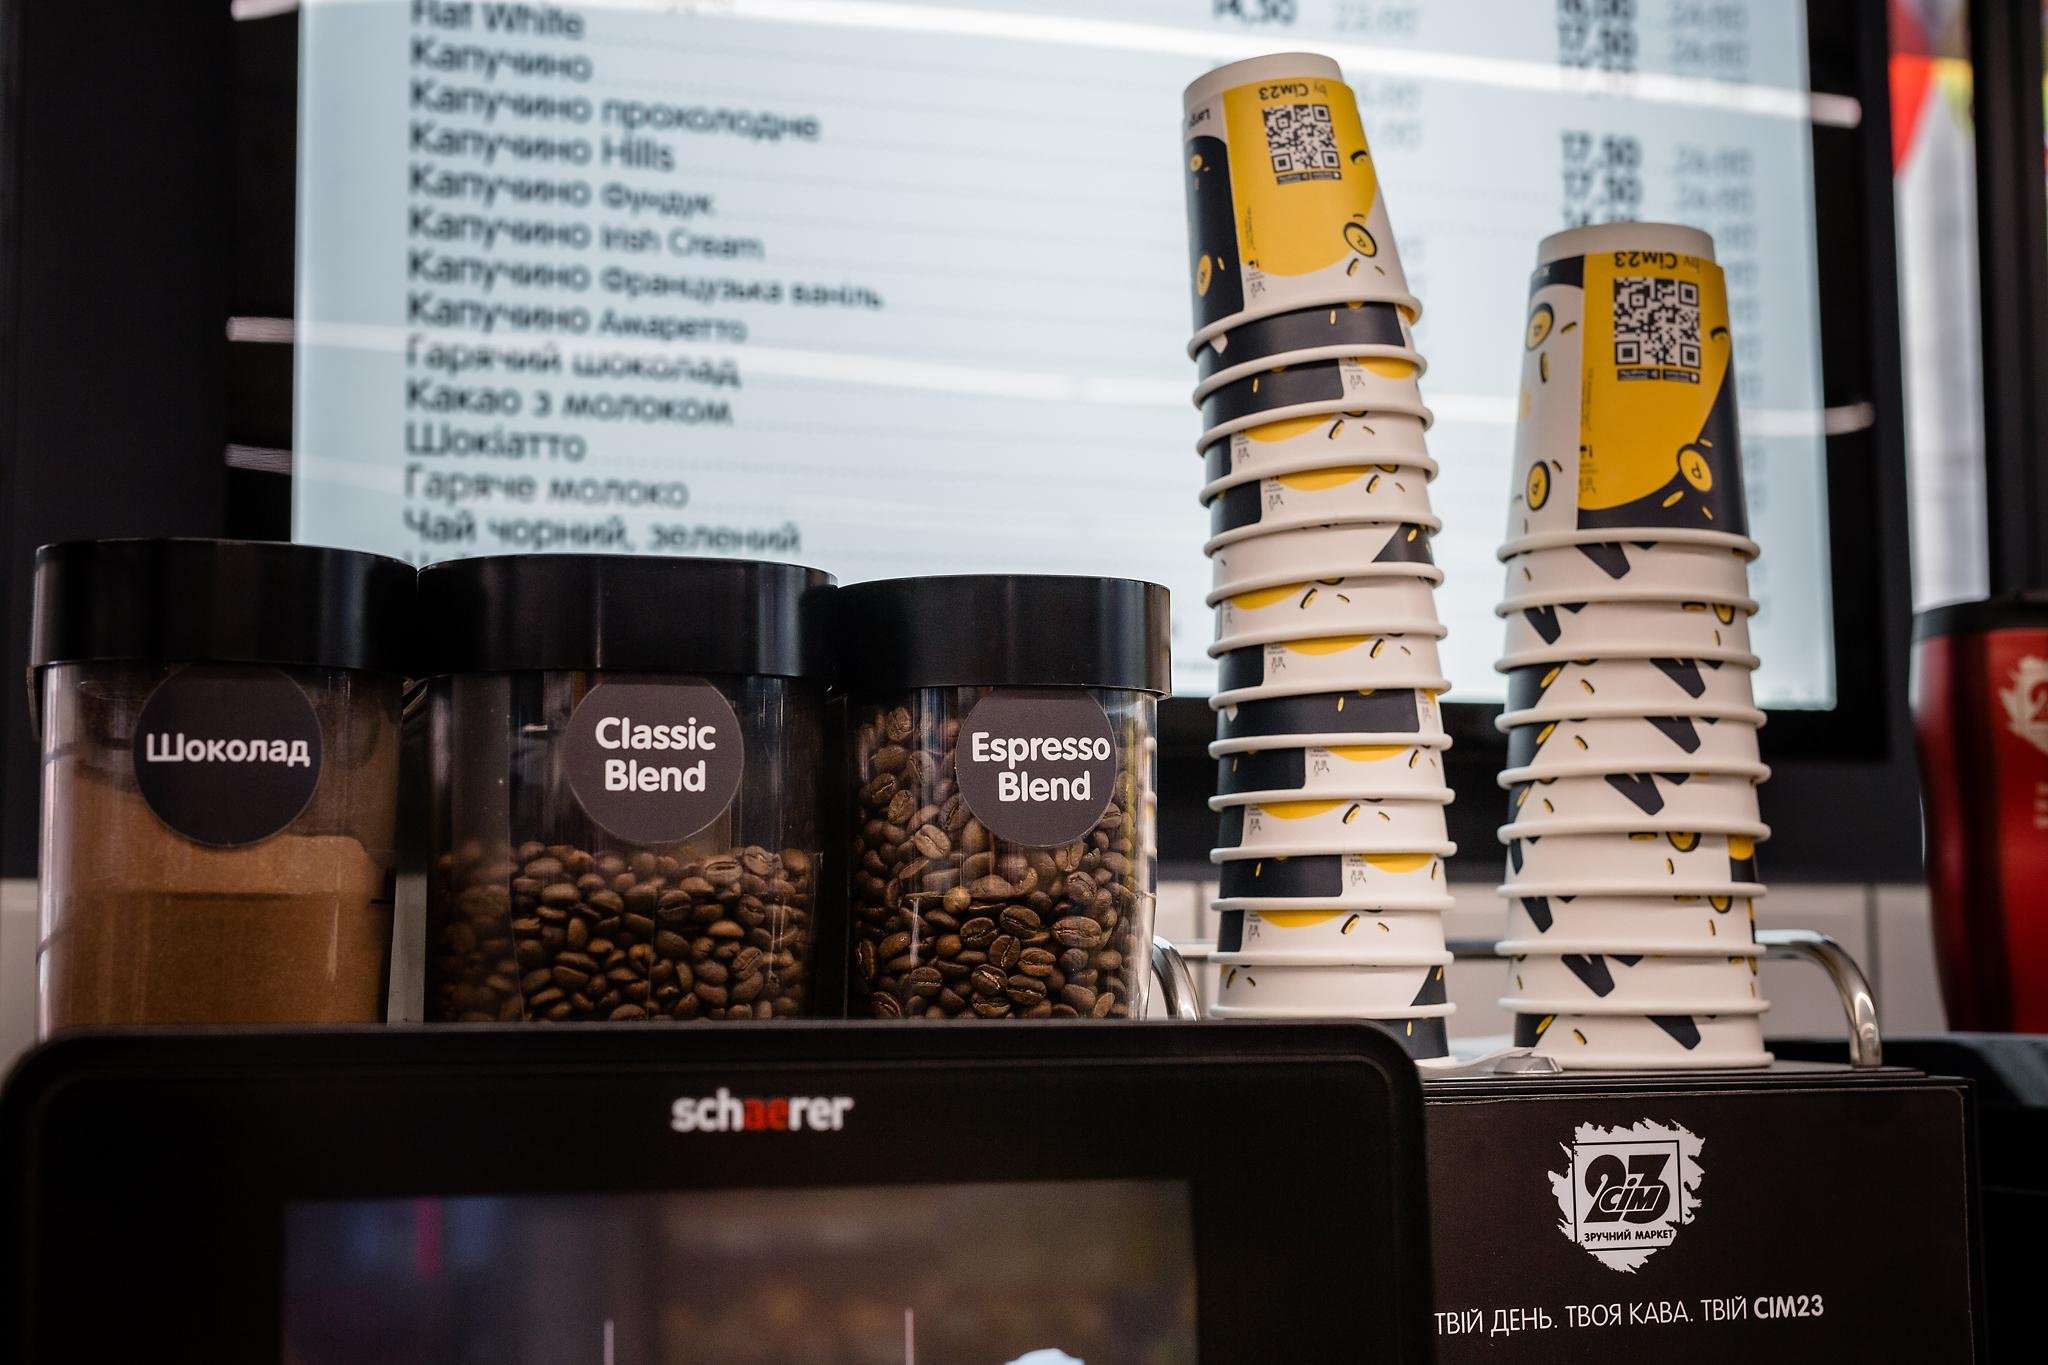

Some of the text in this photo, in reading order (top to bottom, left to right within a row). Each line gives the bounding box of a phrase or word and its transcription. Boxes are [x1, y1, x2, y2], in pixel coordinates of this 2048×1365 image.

[479, 0, 586, 41] White
[410, 34, 594, 83] Капучино
[409, 77, 594, 124] Капучино
[408, 120, 676, 173] Капучино Hills
[408, 162, 593, 209] Капучино
[408, 204, 765, 259] Капучино Irish Cream
[408, 247, 592, 294] Капучино
[407, 290, 750, 345] Капучино Амаретто
[406, 334, 743, 388] Гарячий шоколад
[406, 378, 523, 417] Какао
[563, 392, 735, 427] молоком
[405, 464, 692, 509] Гаряче молоко
[404, 508, 476, 544] Чай
[647, 521, 802, 553] зелений
[146, 733, 311, 767] Шоколад
[595, 717, 716, 750] Classic
[972, 732, 1111, 770] Espresso
[605, 759, 706, 792] Blend
[998, 770, 1091, 802] Blend
[671, 1087, 855, 1132] schaerer
[1584, 1154, 1671, 1225] 23
[1584, 1228, 1674, 1242] ЗРУЧНИЙ МАРКЕТ
[1434, 1308, 1483, 1335] ТВІЙ
[1491, 1307, 1558, 1337] ДЕНЬ.
[1565, 1303, 1622, 1328] ТВОЯ
[1630, 1300, 1694, 1325] КАВА.
[1701, 1295, 1747, 1321] ТВІЙ
